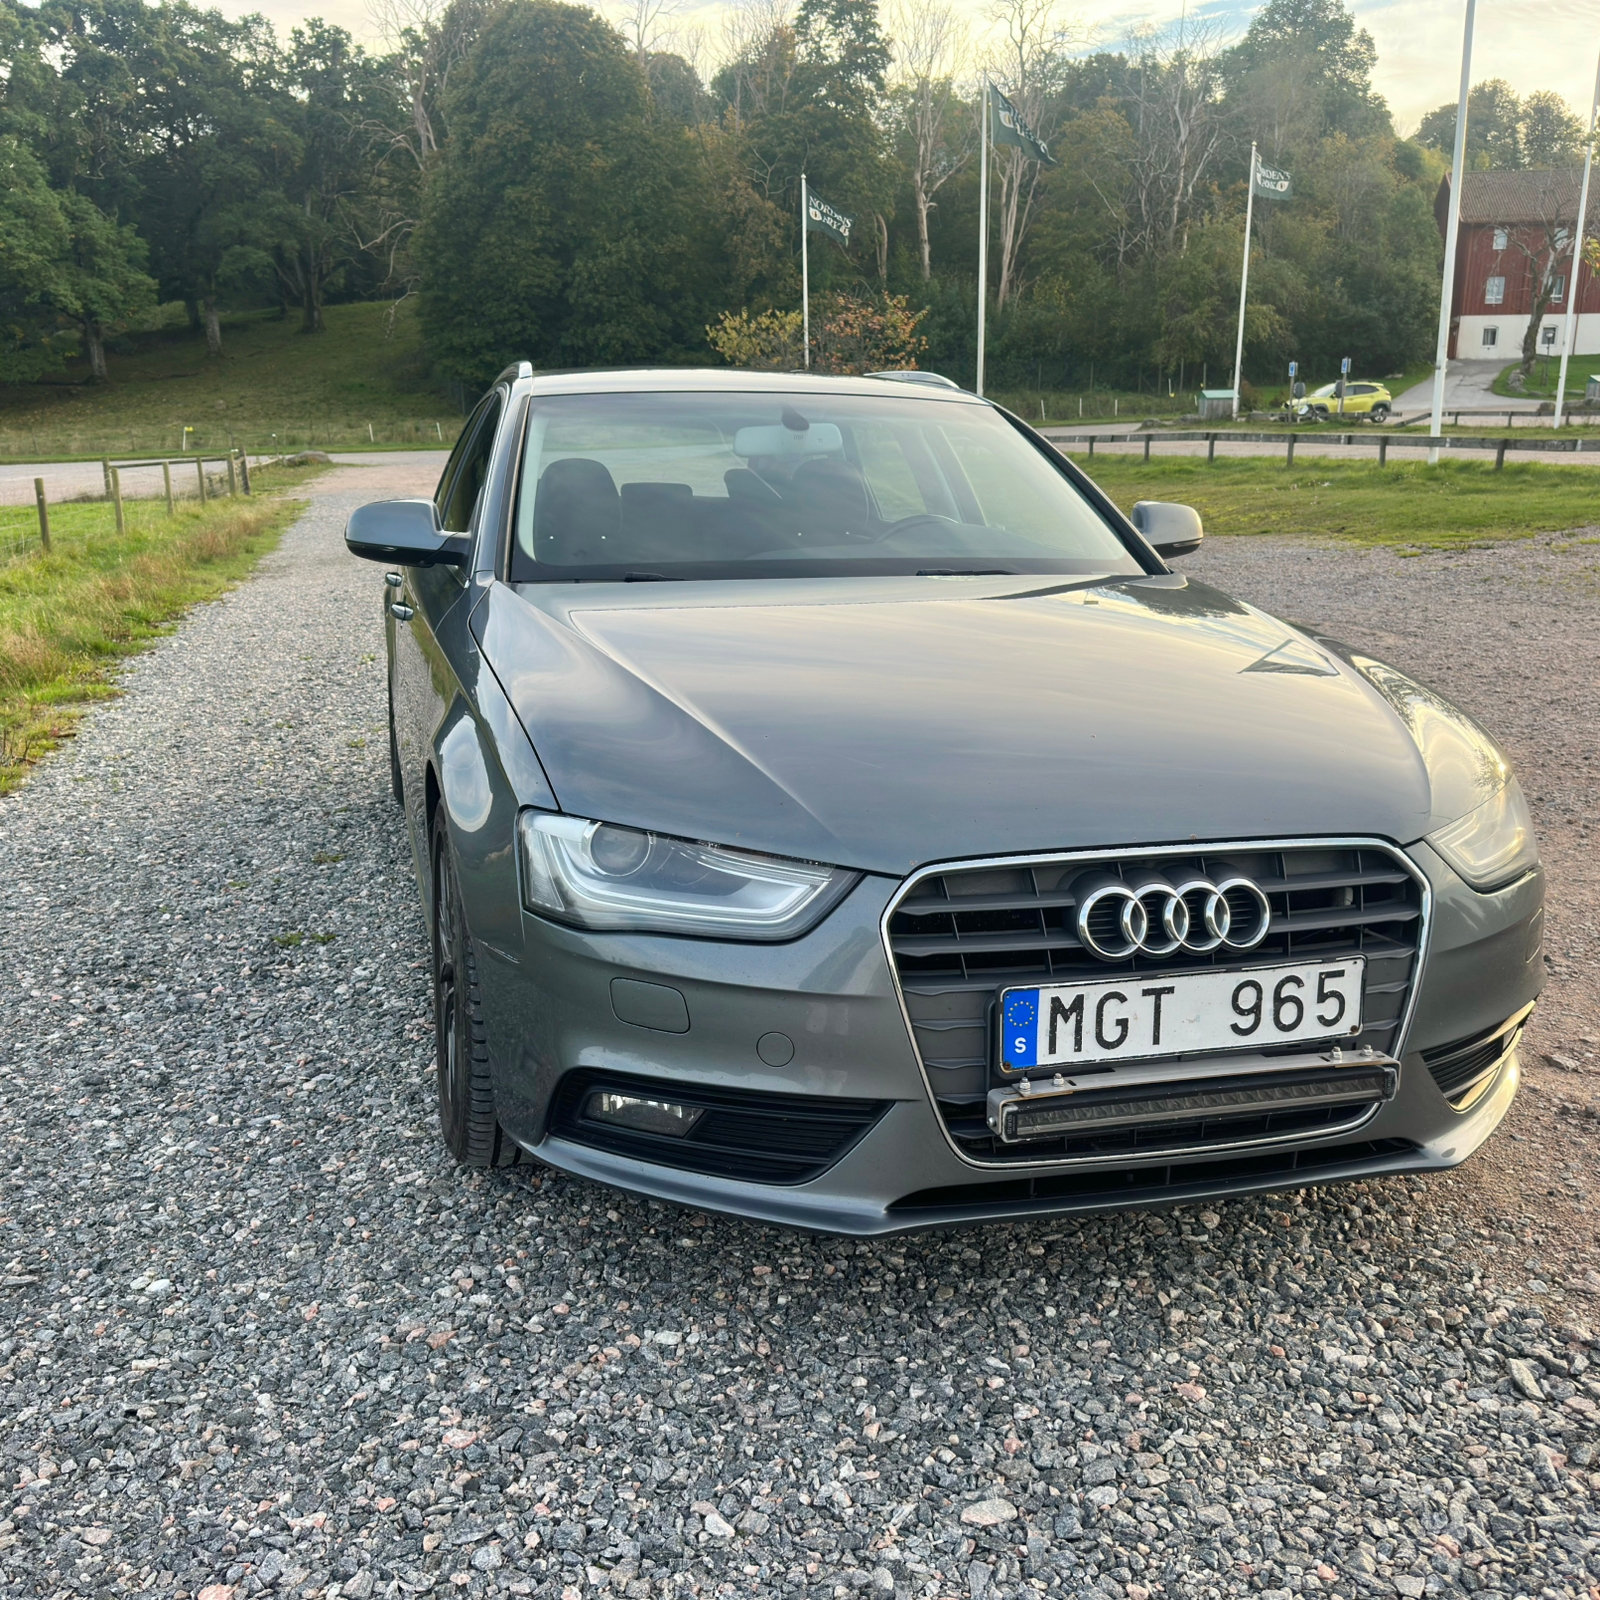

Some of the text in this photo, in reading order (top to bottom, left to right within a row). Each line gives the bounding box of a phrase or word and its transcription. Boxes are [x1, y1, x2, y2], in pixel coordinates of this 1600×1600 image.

[1048, 969, 1346, 1055] MGT 965
[1014, 1038, 1027, 1054] S
